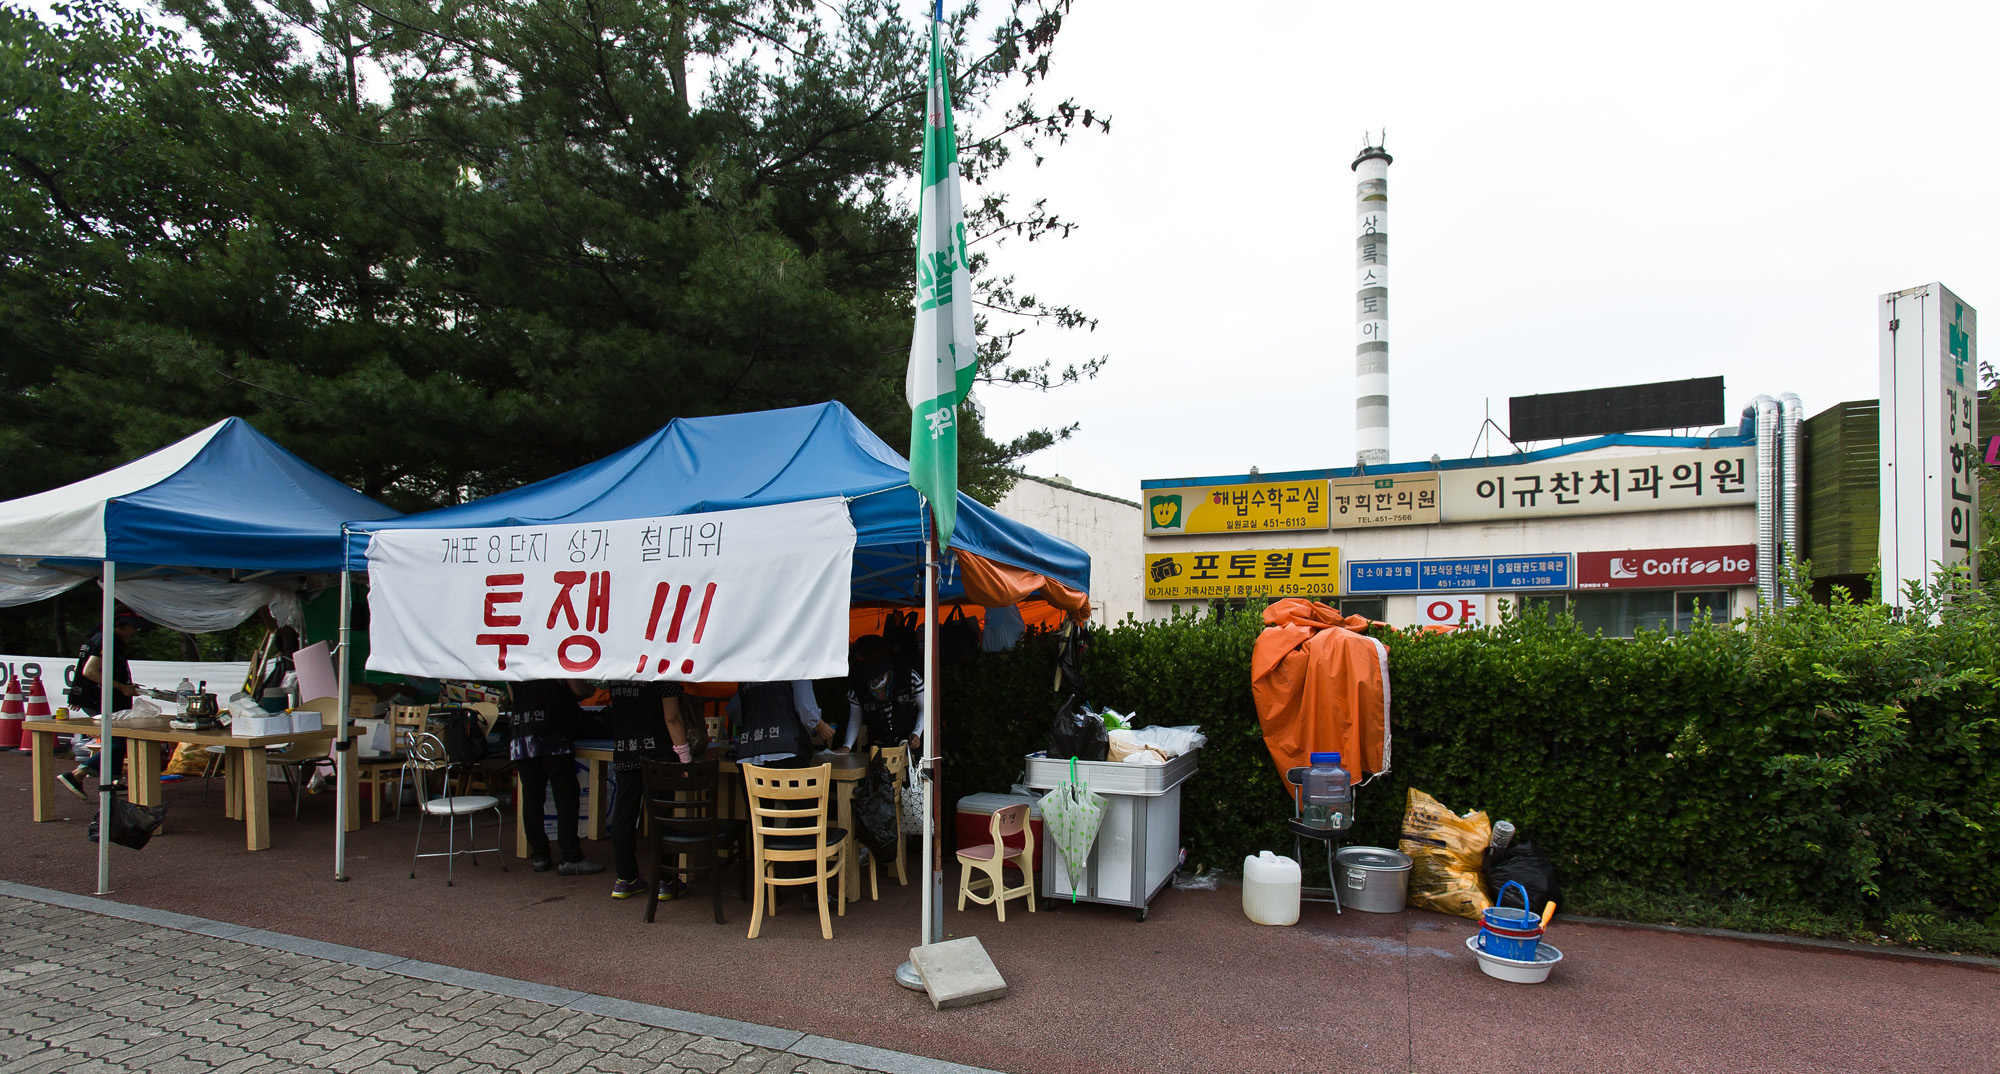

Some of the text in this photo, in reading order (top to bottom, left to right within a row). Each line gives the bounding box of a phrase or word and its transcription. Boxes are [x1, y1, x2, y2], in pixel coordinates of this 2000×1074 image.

[1362, 214, 1379, 341] 상록스토아
[1476, 457, 1746, 509] 이규찬치과의원
[1212, 485, 1319, 516] 해법수학교실
[1335, 490, 1436, 515] 경희한의원
[1226, 517, 1306, 529] 일원교실 451-6113
[1357, 514, 1412, 523] TEL.451-7566
[567, 528, 610, 562] 상가
[641, 522, 724, 562] 철대위
[1190, 551, 1331, 580] 포토월드
[1423, 565, 1453, 576] 개포식당
[1149, 586, 1179, 597] 아기사진
[1184, 585, 1231, 596] 가족사진전문
[1278, 582, 1334, 594] 459-2030
[1437, 579, 1476, 588] 451-1289
[1511, 577, 1551, 585] 451-1308
[476, 570, 611, 672] 투쟁
[740, 725, 780, 745] 전.철.연
